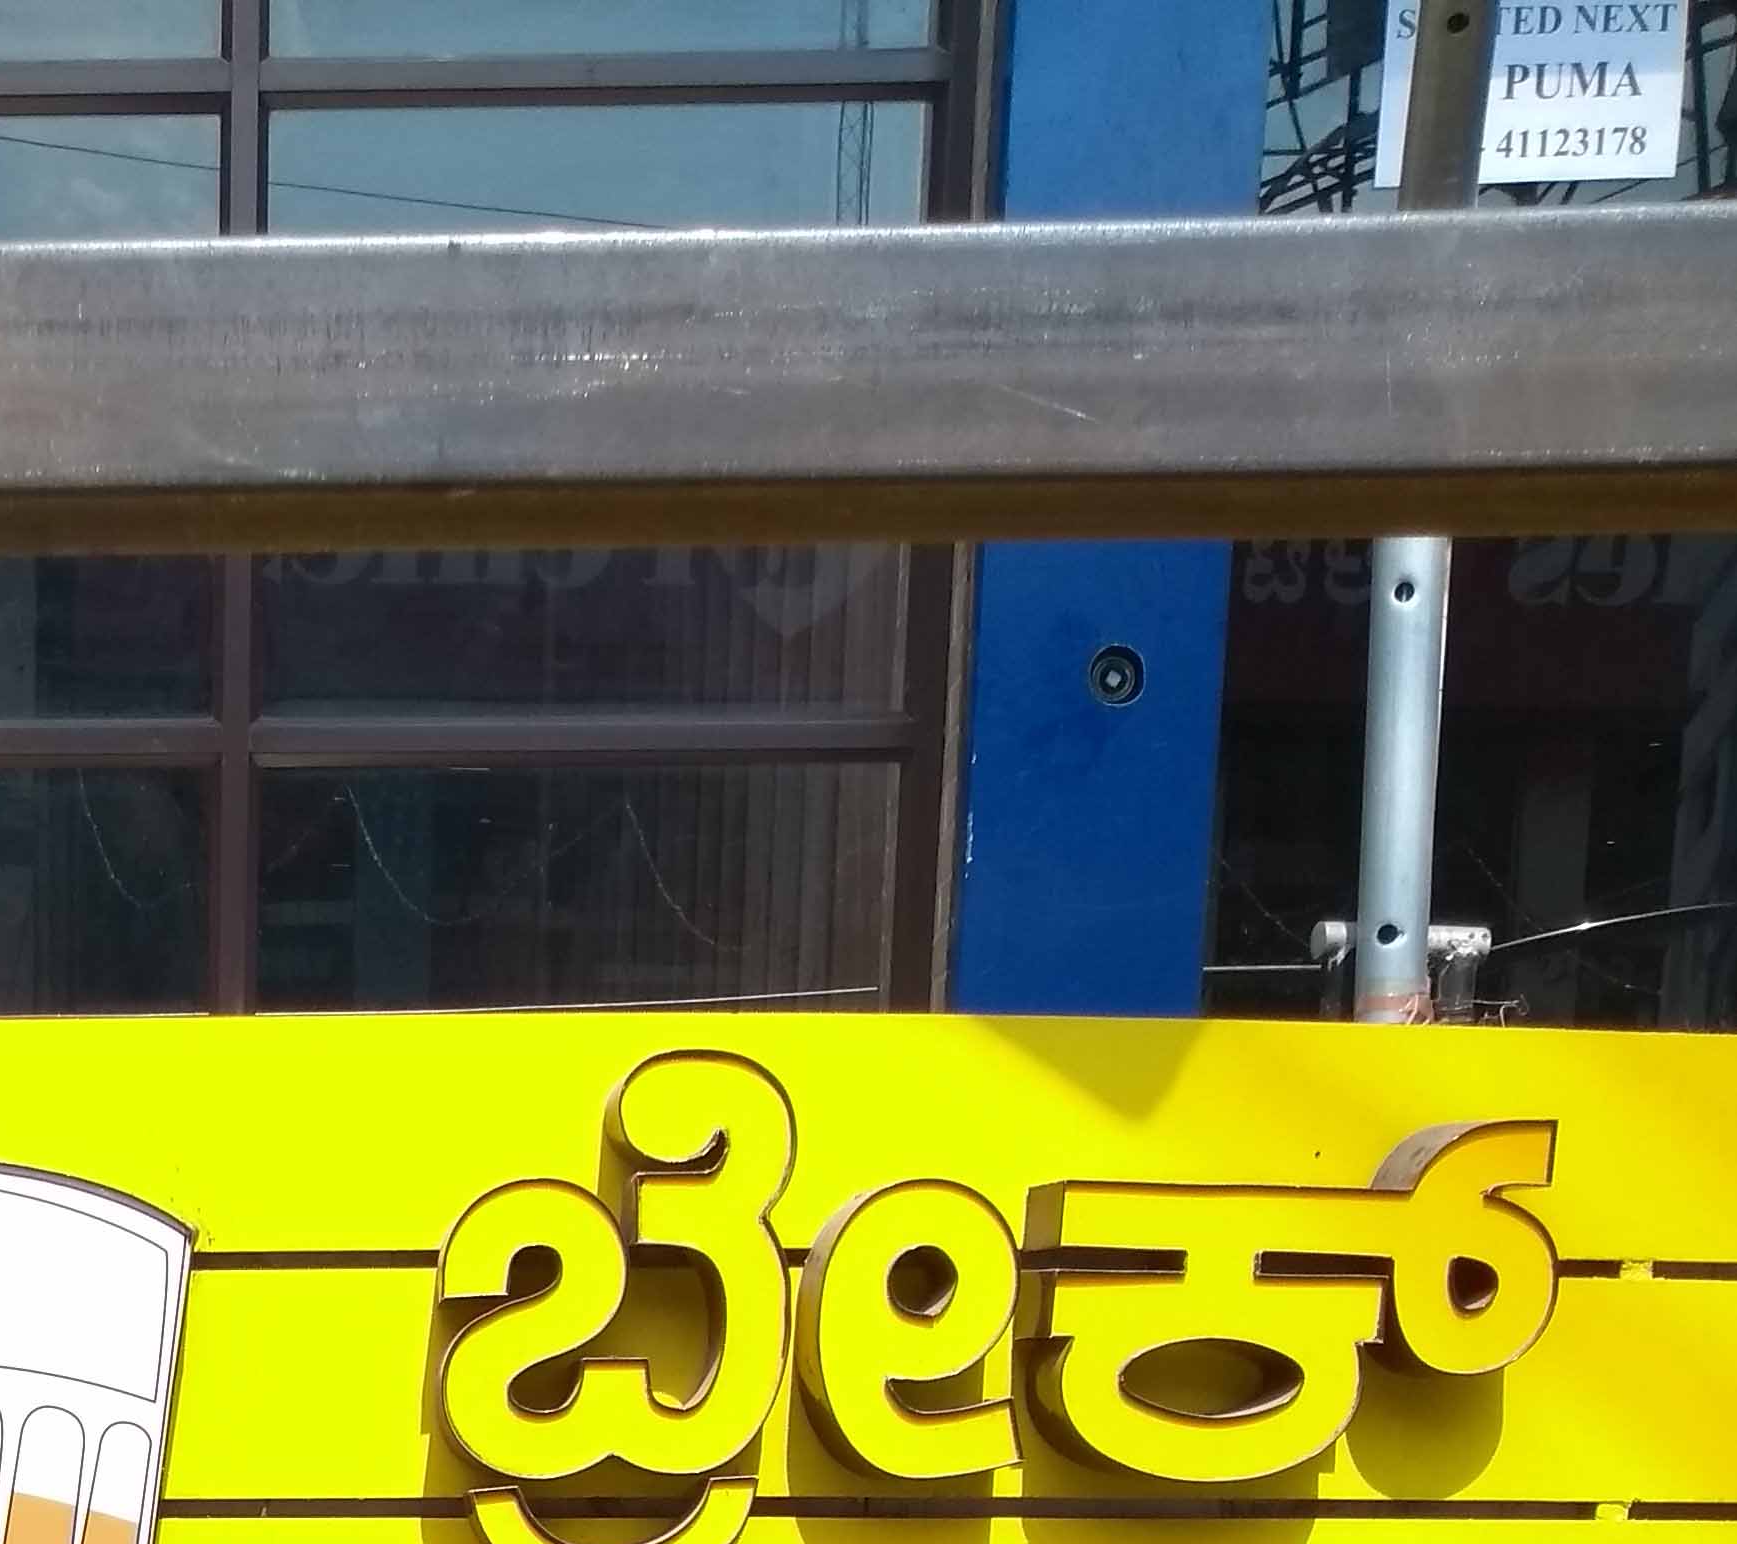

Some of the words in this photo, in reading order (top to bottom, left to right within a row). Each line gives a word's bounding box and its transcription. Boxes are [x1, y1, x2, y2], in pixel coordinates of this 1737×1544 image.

[1573, 3, 1678, 34] NEXT
[1503, 60, 1642, 100] PUMA
[1495, 125, 1648, 159] 41123178
